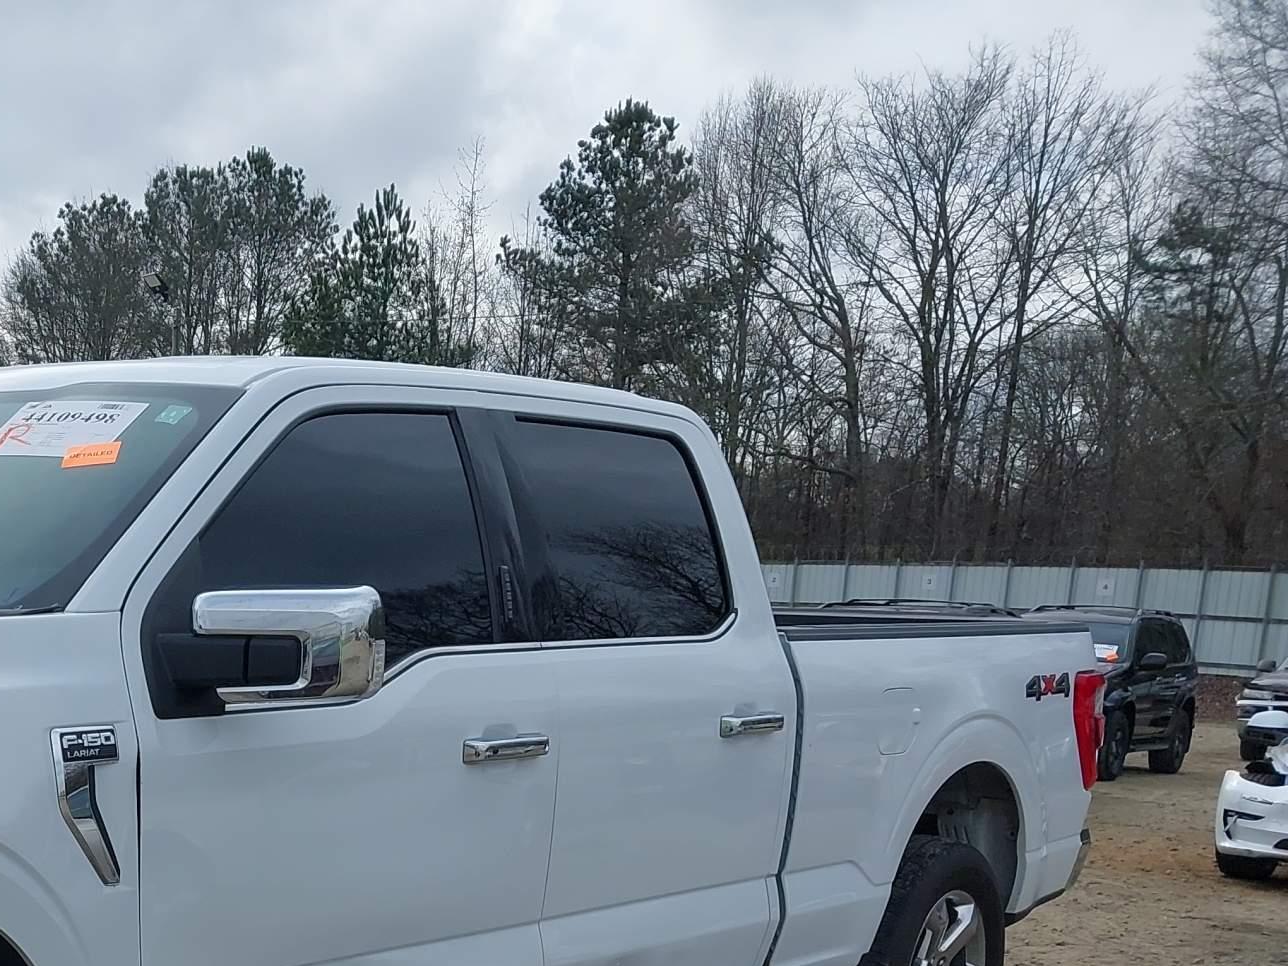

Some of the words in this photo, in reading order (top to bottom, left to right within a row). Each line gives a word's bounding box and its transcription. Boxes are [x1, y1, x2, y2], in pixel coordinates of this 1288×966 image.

[22, 411, 121, 424] 44109498
[69, 449, 113, 459] DETAILED
[62, 732, 115, 748] F-150
[67, 748, 100, 759] LARIAT
